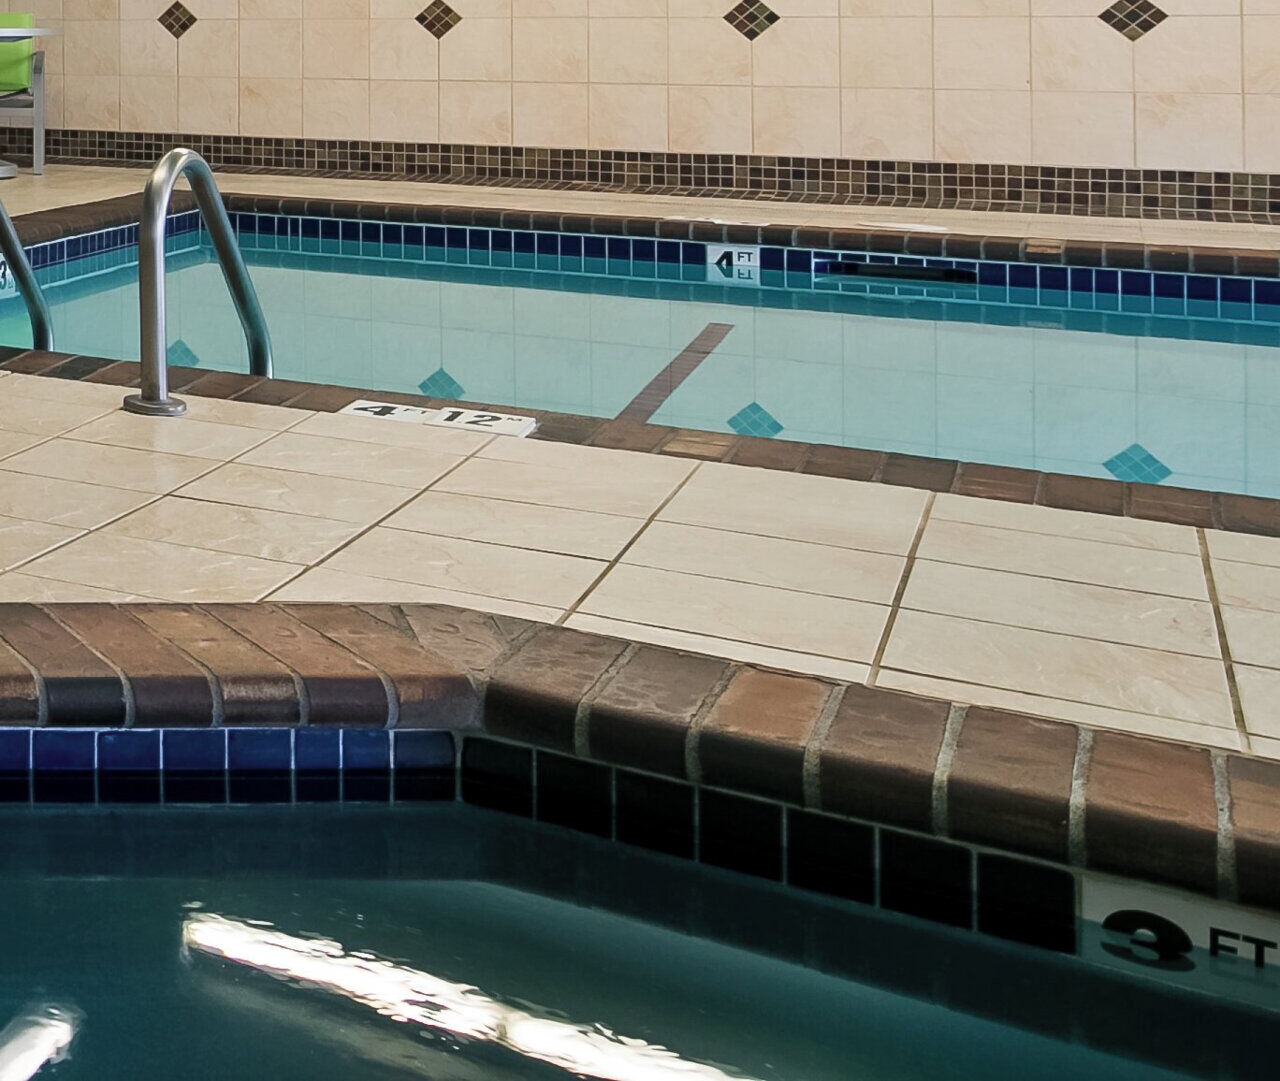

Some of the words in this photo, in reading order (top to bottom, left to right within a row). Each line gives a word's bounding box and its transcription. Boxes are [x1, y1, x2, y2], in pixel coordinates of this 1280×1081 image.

[738, 251, 753, 262] FT
[353, 406, 397, 416] 4
[1210, 927, 1278, 968] FT
